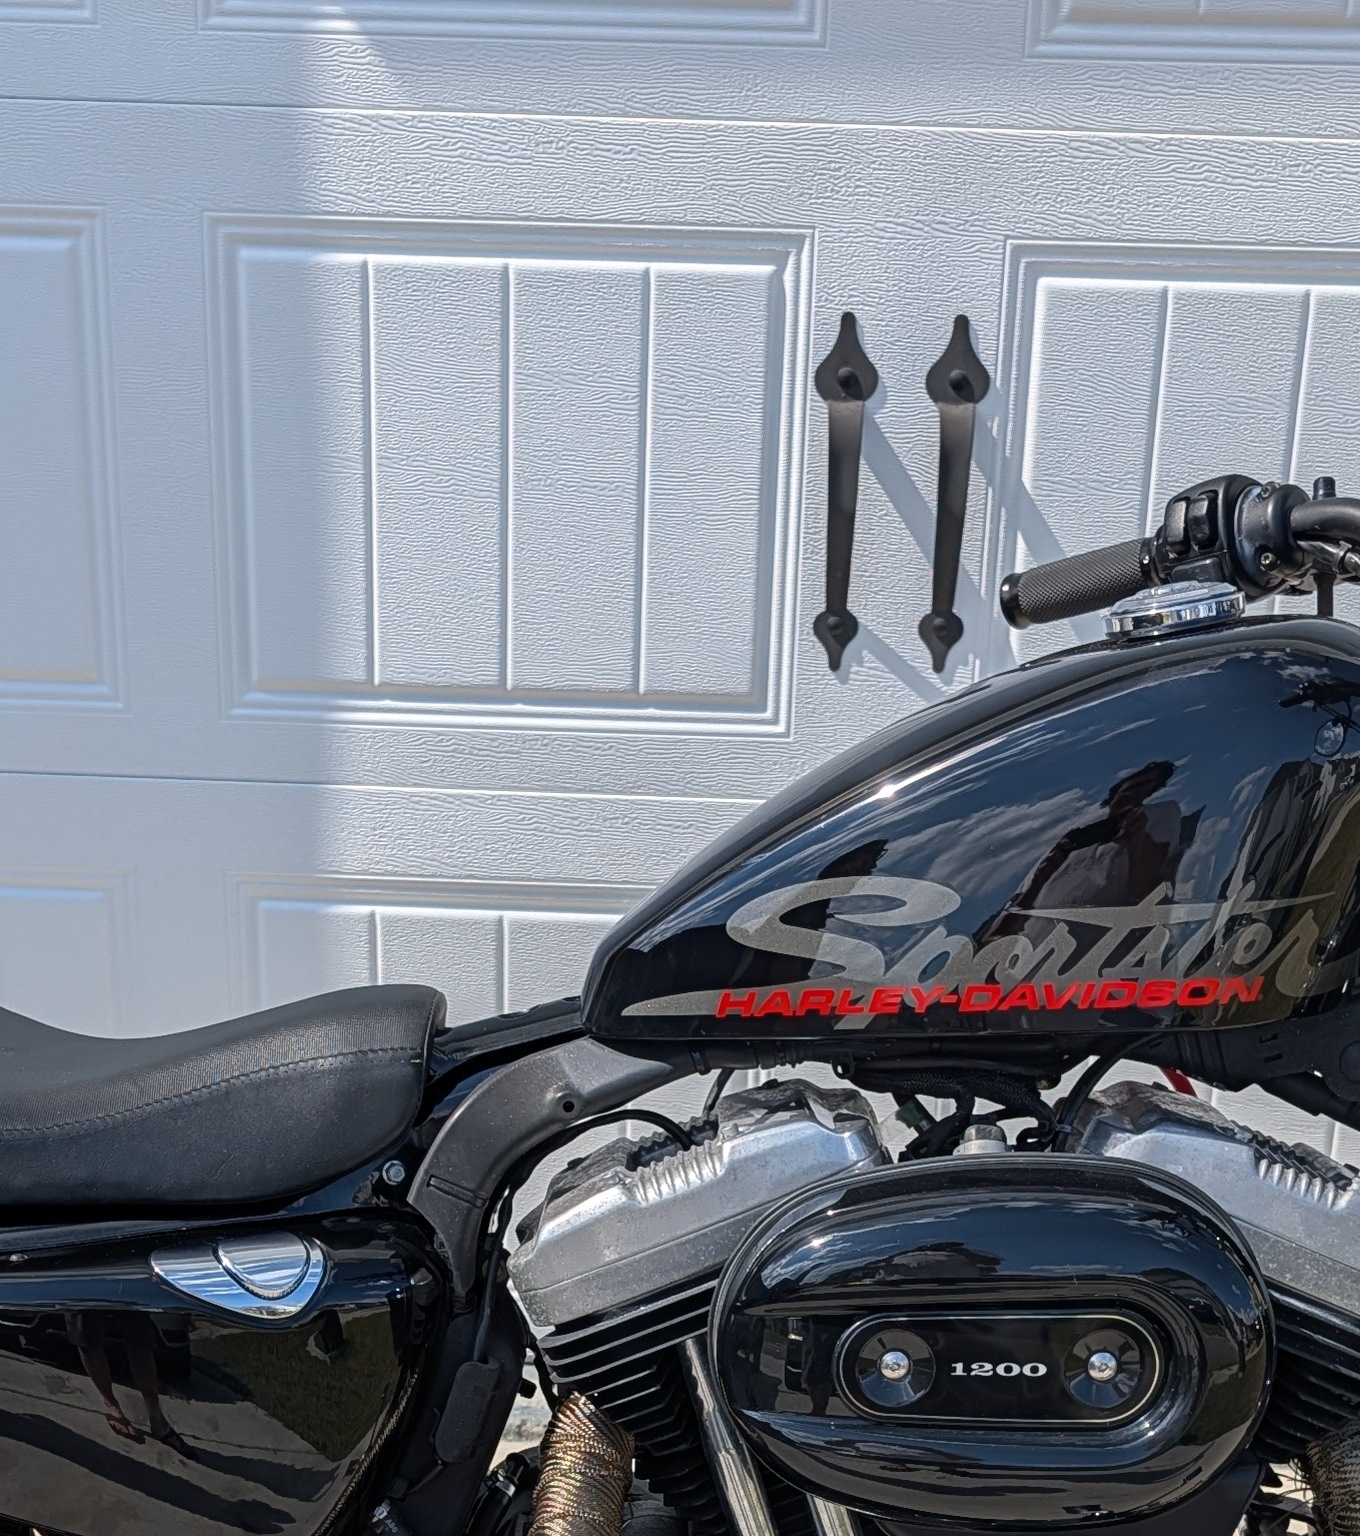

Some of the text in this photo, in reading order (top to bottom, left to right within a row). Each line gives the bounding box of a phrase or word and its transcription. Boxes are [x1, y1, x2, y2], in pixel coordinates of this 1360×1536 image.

[622, 875, 1360, 1030] Sportster
[715, 976, 1264, 1018] HARLEY-DAVIDSON
[950, 1361, 1048, 1378] 1200
